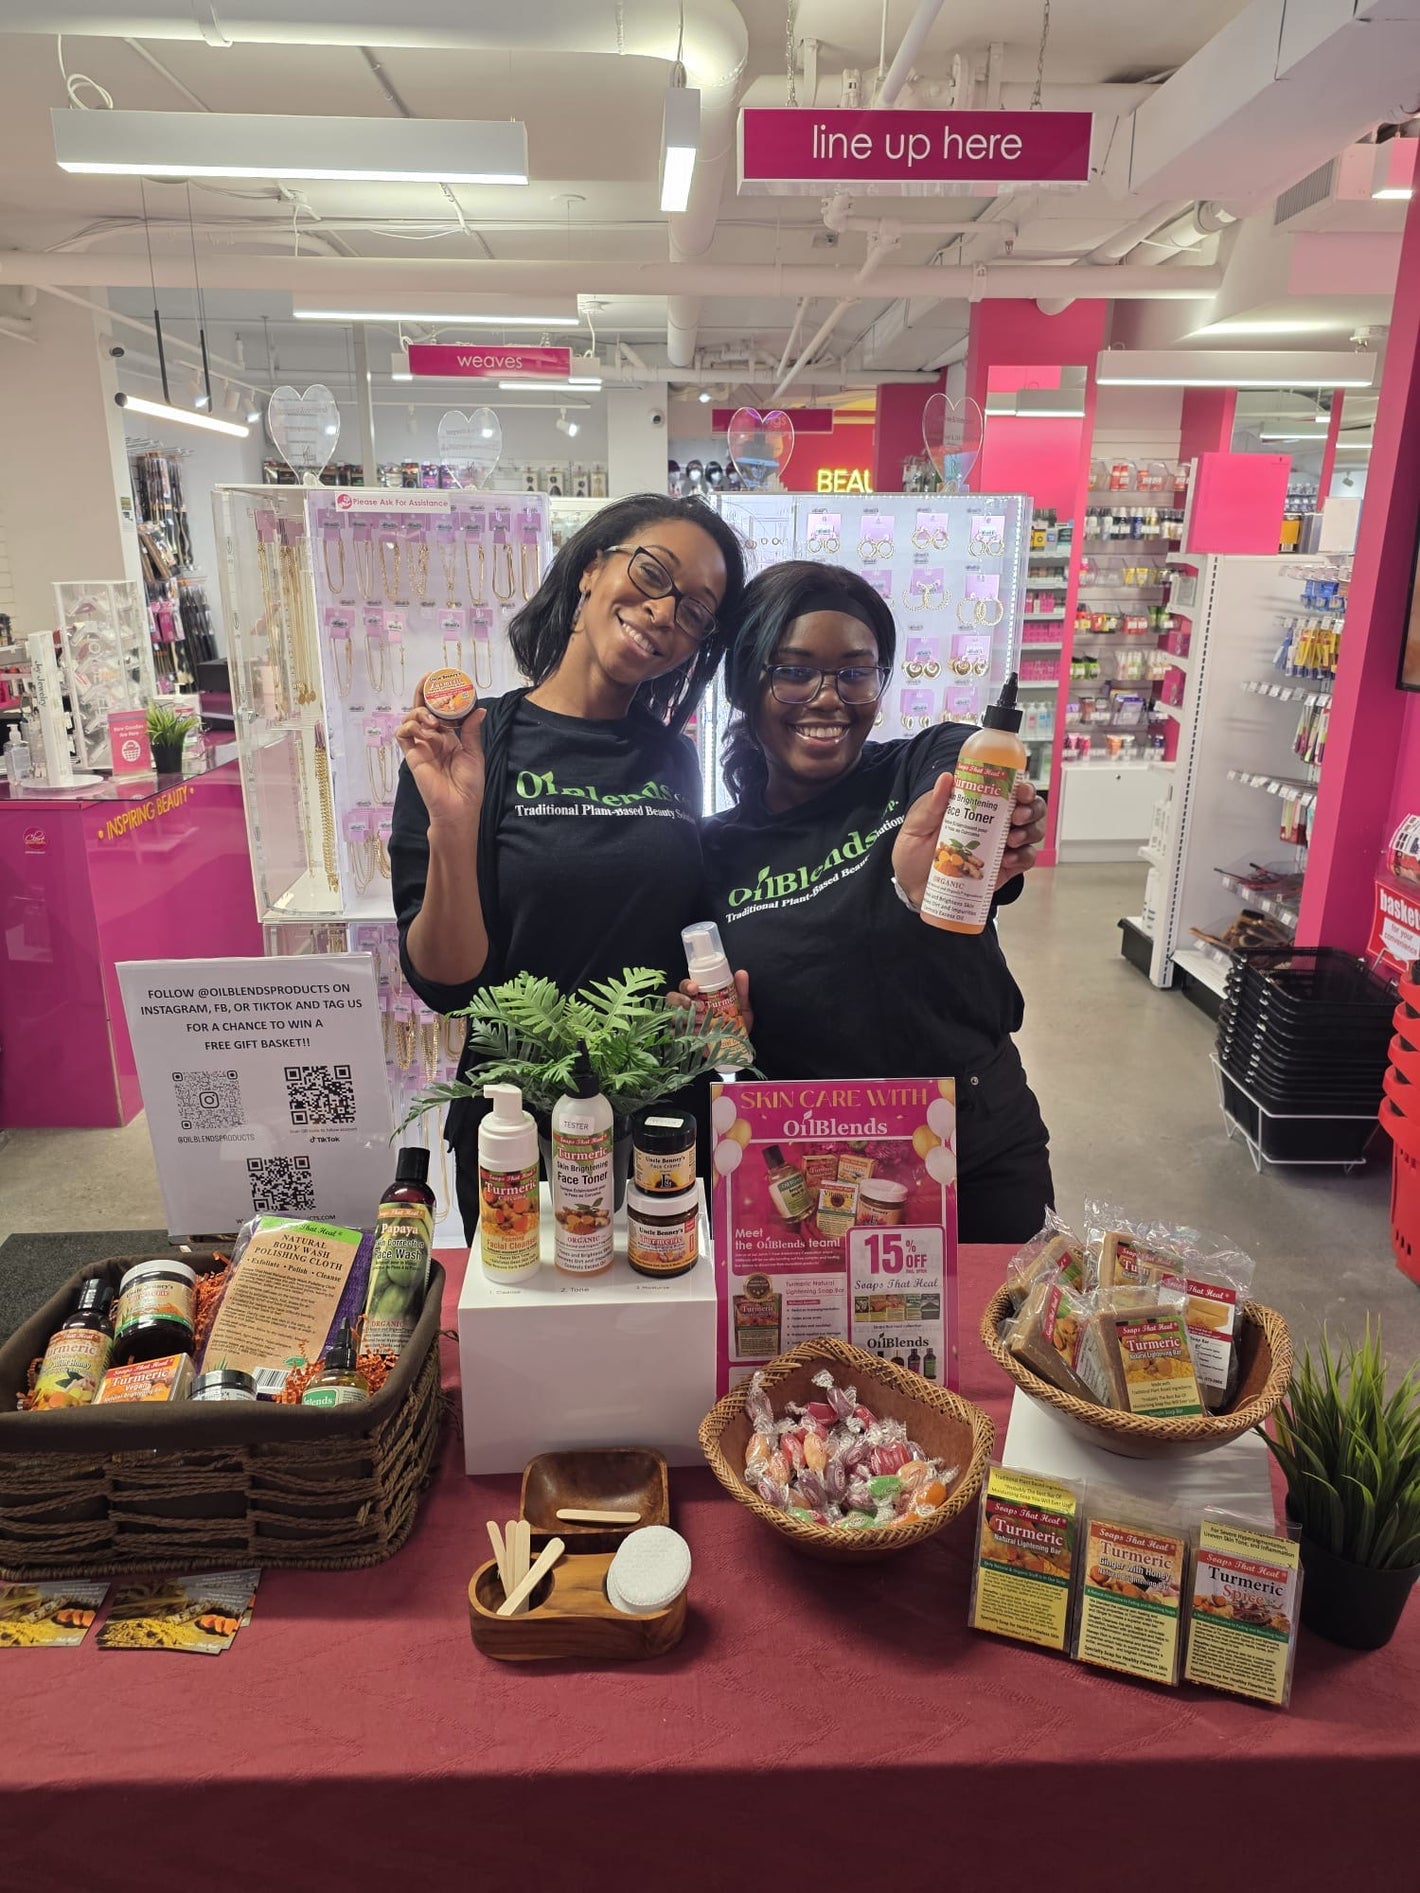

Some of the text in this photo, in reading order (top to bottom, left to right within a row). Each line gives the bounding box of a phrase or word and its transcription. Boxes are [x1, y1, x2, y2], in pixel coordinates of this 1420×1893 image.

[812, 124, 1023, 167] line up here
[456, 355, 523, 369] weaves
[353, 498, 377, 506] Please
[380, 498, 393, 506] Ask
[408, 499, 449, 507] Assistance
[957, 793, 998, 812] Brightening
[106, 785, 188, 840] INSPIRING BEAUTY
[515, 804, 579, 817] Traditional
[646, 805, 675, 819] Beauty
[963, 807, 995, 825] Toner
[933, 875, 965, 890] ORGANIC
[725, 900, 779, 923] Traditional
[781, 873, 840, 908] Plant-Based
[1400, 930, 1413, 941] your
[1384, 932, 1418, 955] convenience
[148, 984, 351, 999] FOLLOW @OILBLENDSPRODUCTS ON
[141, 999, 363, 1016] INSTAGRAM, FB, OR TIKTOK AND TAG US
[186, 1018, 324, 1033] FOR A CHANCE TO WIN A
[204, 1037, 312, 1051] FREE GIFT BASKET!!
[740, 1088, 928, 1110] SKIN CARE WITH
[564, 1120, 588, 1129] TESTER
[783, 1110, 888, 1137] OilBlends
[177, 1133, 256, 1144] @OILBLENDSPRODUCTS
[557, 1145, 607, 1161] Turmeric
[557, 1161, 608, 1173] Skin Brightening
[557, 1171, 608, 1185] Face Toner
[485, 1179, 536, 1195] Turmeric
[301, 1224, 336, 1237] That Heal
[381, 1223, 418, 1237] Papaya
[640, 1227, 655, 1235] Uncle
[735, 1228, 763, 1238] Meet
[282, 1234, 327, 1249] NATURAL
[568, 1236, 600, 1244] ORGANIC
[735, 1236, 840, 1250] the OilBlends team!
[273, 1241, 330, 1258] BODY WASH
[395, 1248, 421, 1260] Wash
[864, 1233, 904, 1274] 15
[906, 1240, 916, 1253] %
[254, 1247, 343, 1271] POLISHING CLOTH
[906, 1254, 927, 1268] OFF
[287, 1265, 308, 1274] Polish
[316, 1271, 342, 1282] Cleanse
[854, 1278, 938, 1291] Soaps That Heal
[1187, 1284, 1225, 1299] That Heal
[1122, 1326, 1140, 1335] Soaps
[867, 1332, 929, 1348] OilBlends
[1127, 1336, 1180, 1351] Turmeric
[1147, 1351, 1172, 1359] Lightening
[112, 1369, 167, 1387] Turmeric
[994, 1503, 1060, 1525] Soaps That Heal
[996, 1518, 1063, 1546] Turmeric
[1099, 1528, 1168, 1551] Soaps That Heal
[1220, 1530, 1237, 1538] Severe
[994, 1533, 1061, 1555] Natural Lightening Bar
[1204, 1531, 1223, 1540] Uneven
[1260, 1544, 1295, 1558] Inflammation
[1101, 1540, 1172, 1569] Turmeric
[1127, 1564, 1144, 1575] with
[1145, 1568, 1171, 1582] Honey
[1206, 1553, 1280, 1578] Soaps That Heal
[1208, 1565, 1284, 1597] Turmeric
[1222, 1583, 1264, 1606] Spice
